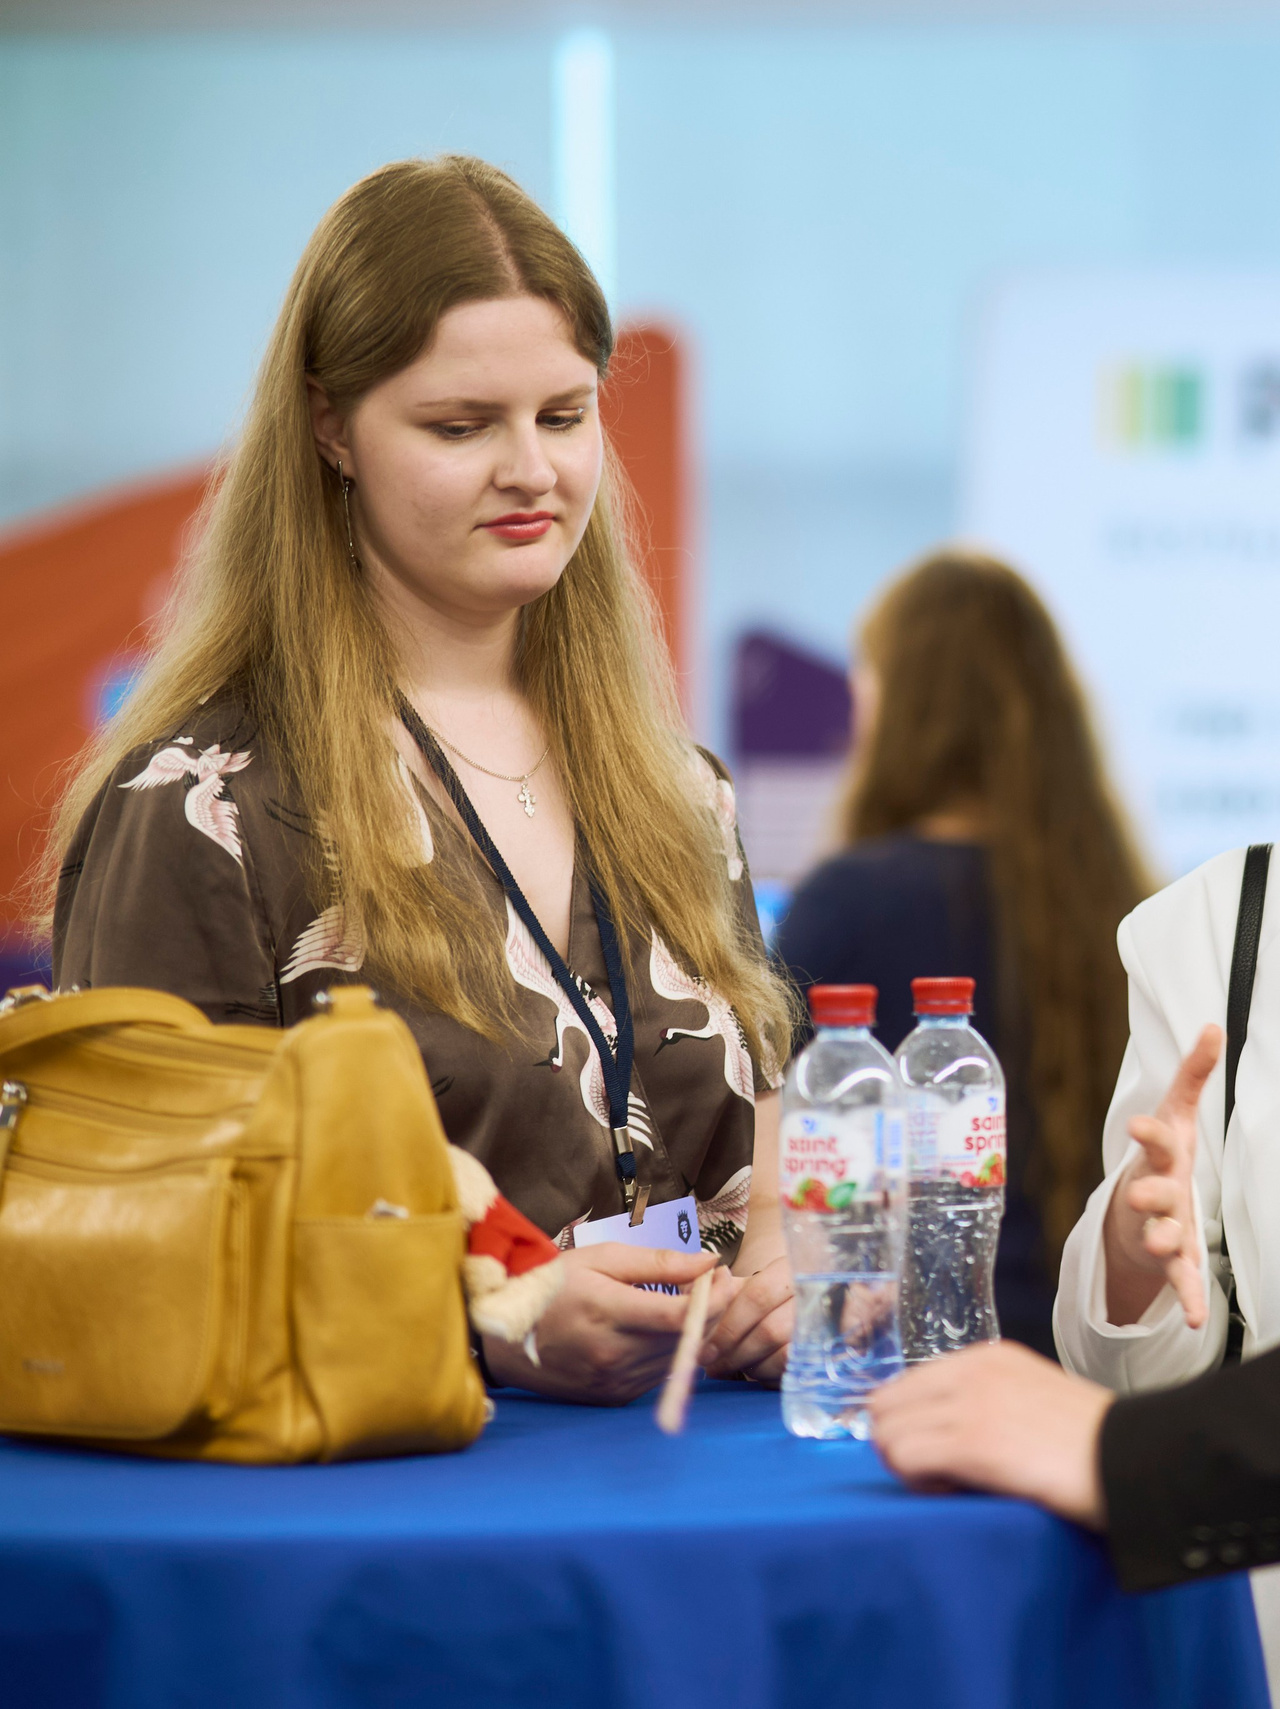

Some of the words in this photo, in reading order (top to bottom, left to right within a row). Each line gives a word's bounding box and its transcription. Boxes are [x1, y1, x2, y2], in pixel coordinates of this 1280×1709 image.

[971, 1115, 1006, 1131] sain
[788, 1136, 838, 1154] saint
[964, 1134, 1006, 1156] sprin
